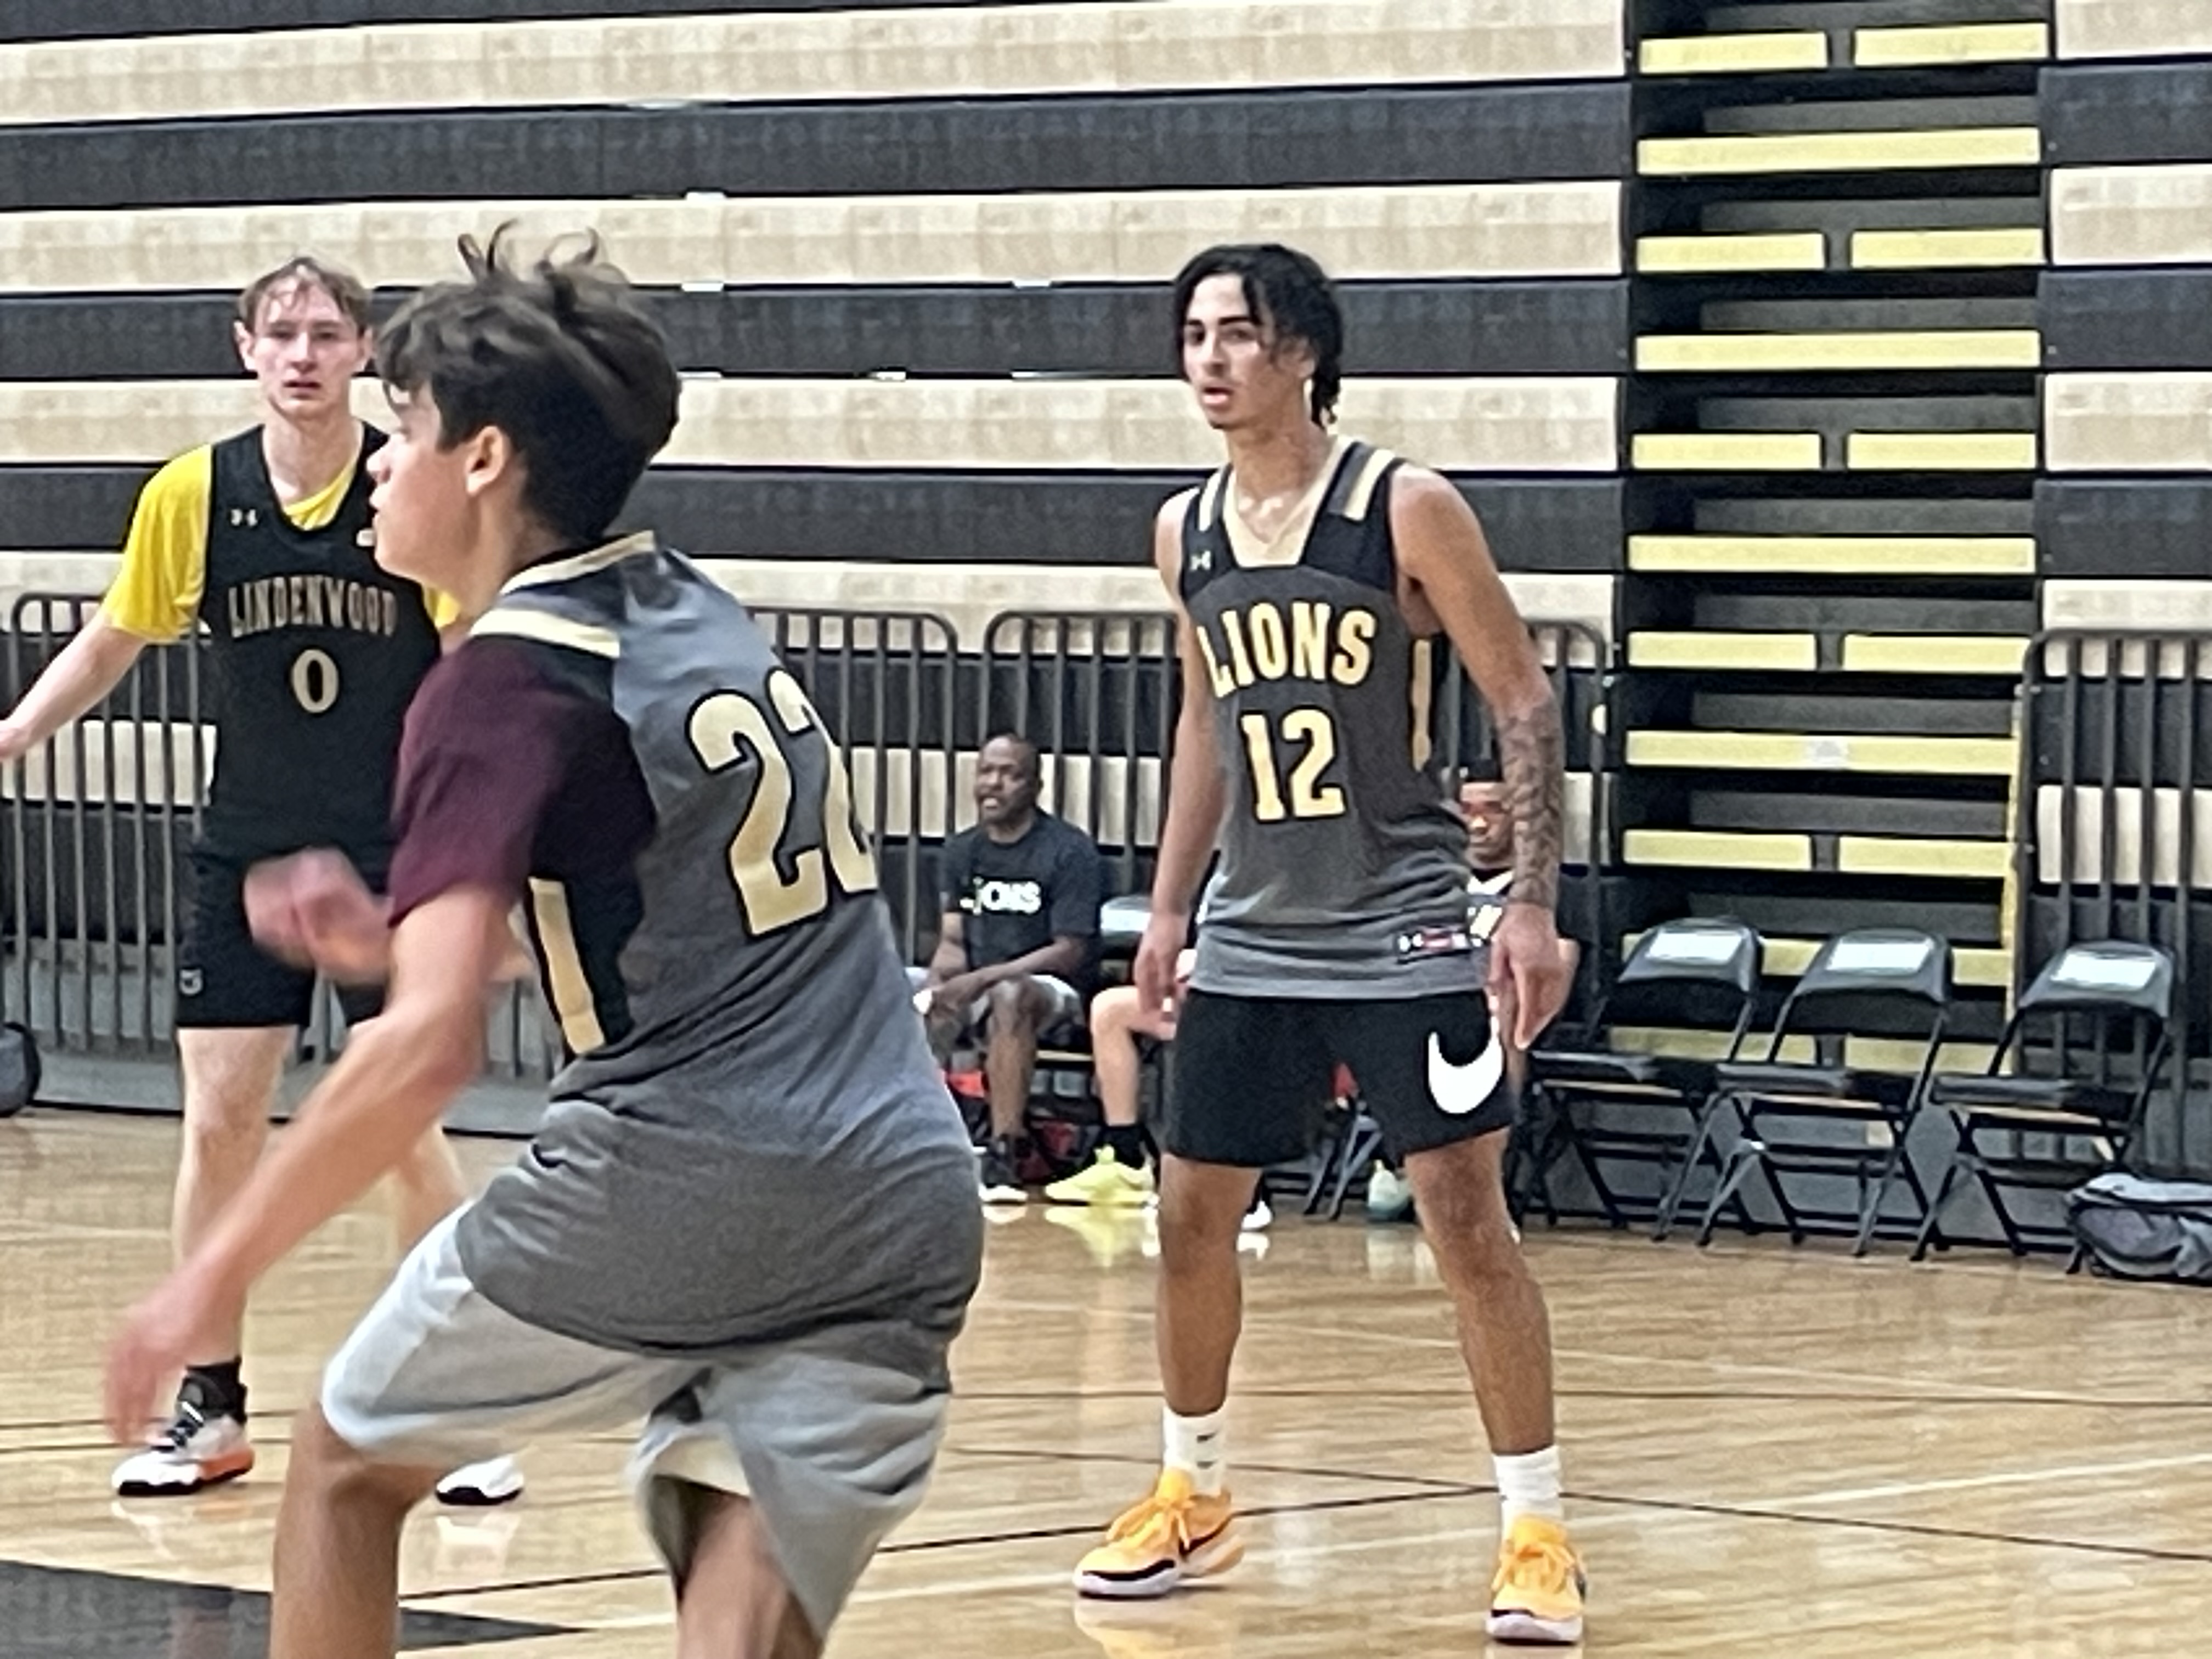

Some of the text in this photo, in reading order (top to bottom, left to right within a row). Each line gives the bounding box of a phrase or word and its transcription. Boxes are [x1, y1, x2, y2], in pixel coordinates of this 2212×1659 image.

[228, 574, 397, 638] LINDENWOOD
[291, 648, 339, 713] 0
[1196, 601, 1376, 699] LIONS
[1240, 708, 1346, 821] 12
